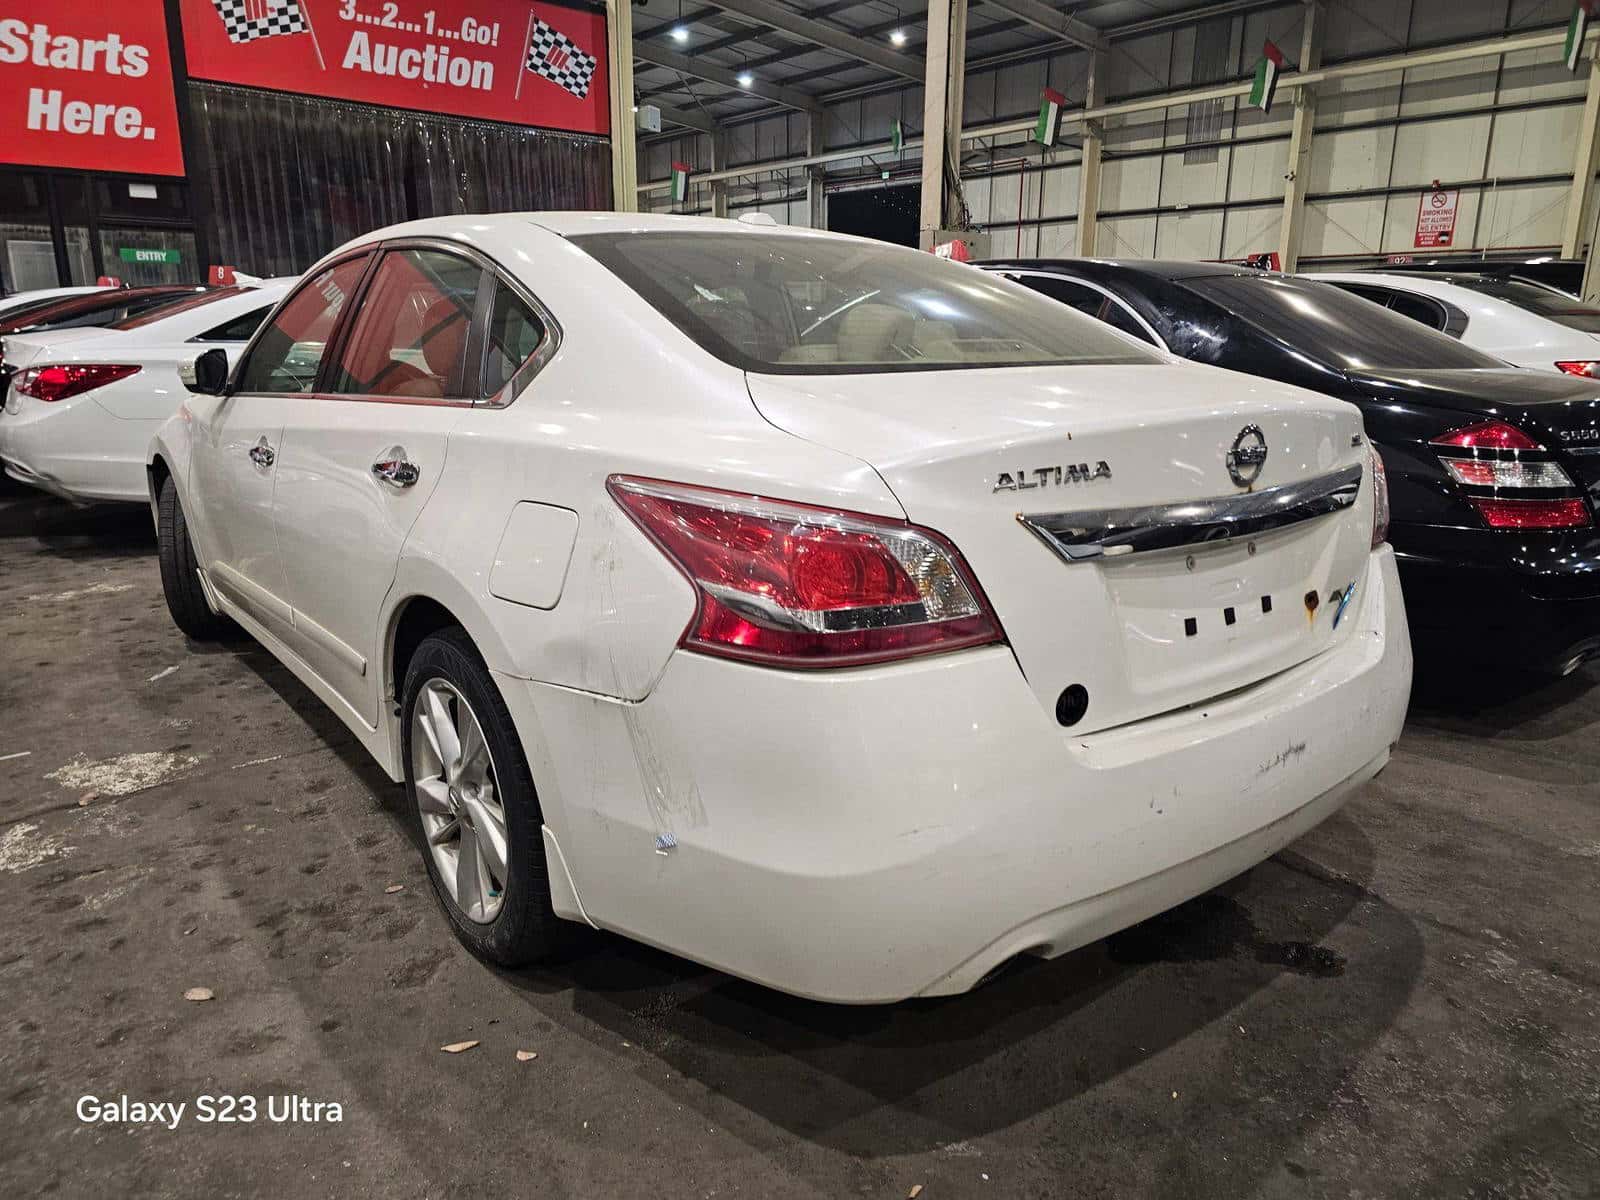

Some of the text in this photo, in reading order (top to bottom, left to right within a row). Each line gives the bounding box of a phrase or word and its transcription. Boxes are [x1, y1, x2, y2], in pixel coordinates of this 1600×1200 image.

[0, 19, 149, 78] Starts
[342, 30, 494, 91] Auction
[27, 88, 155, 140] Here.
[136, 251, 166, 261] ENTRY
[993, 461, 1112, 493] ALTIMA
